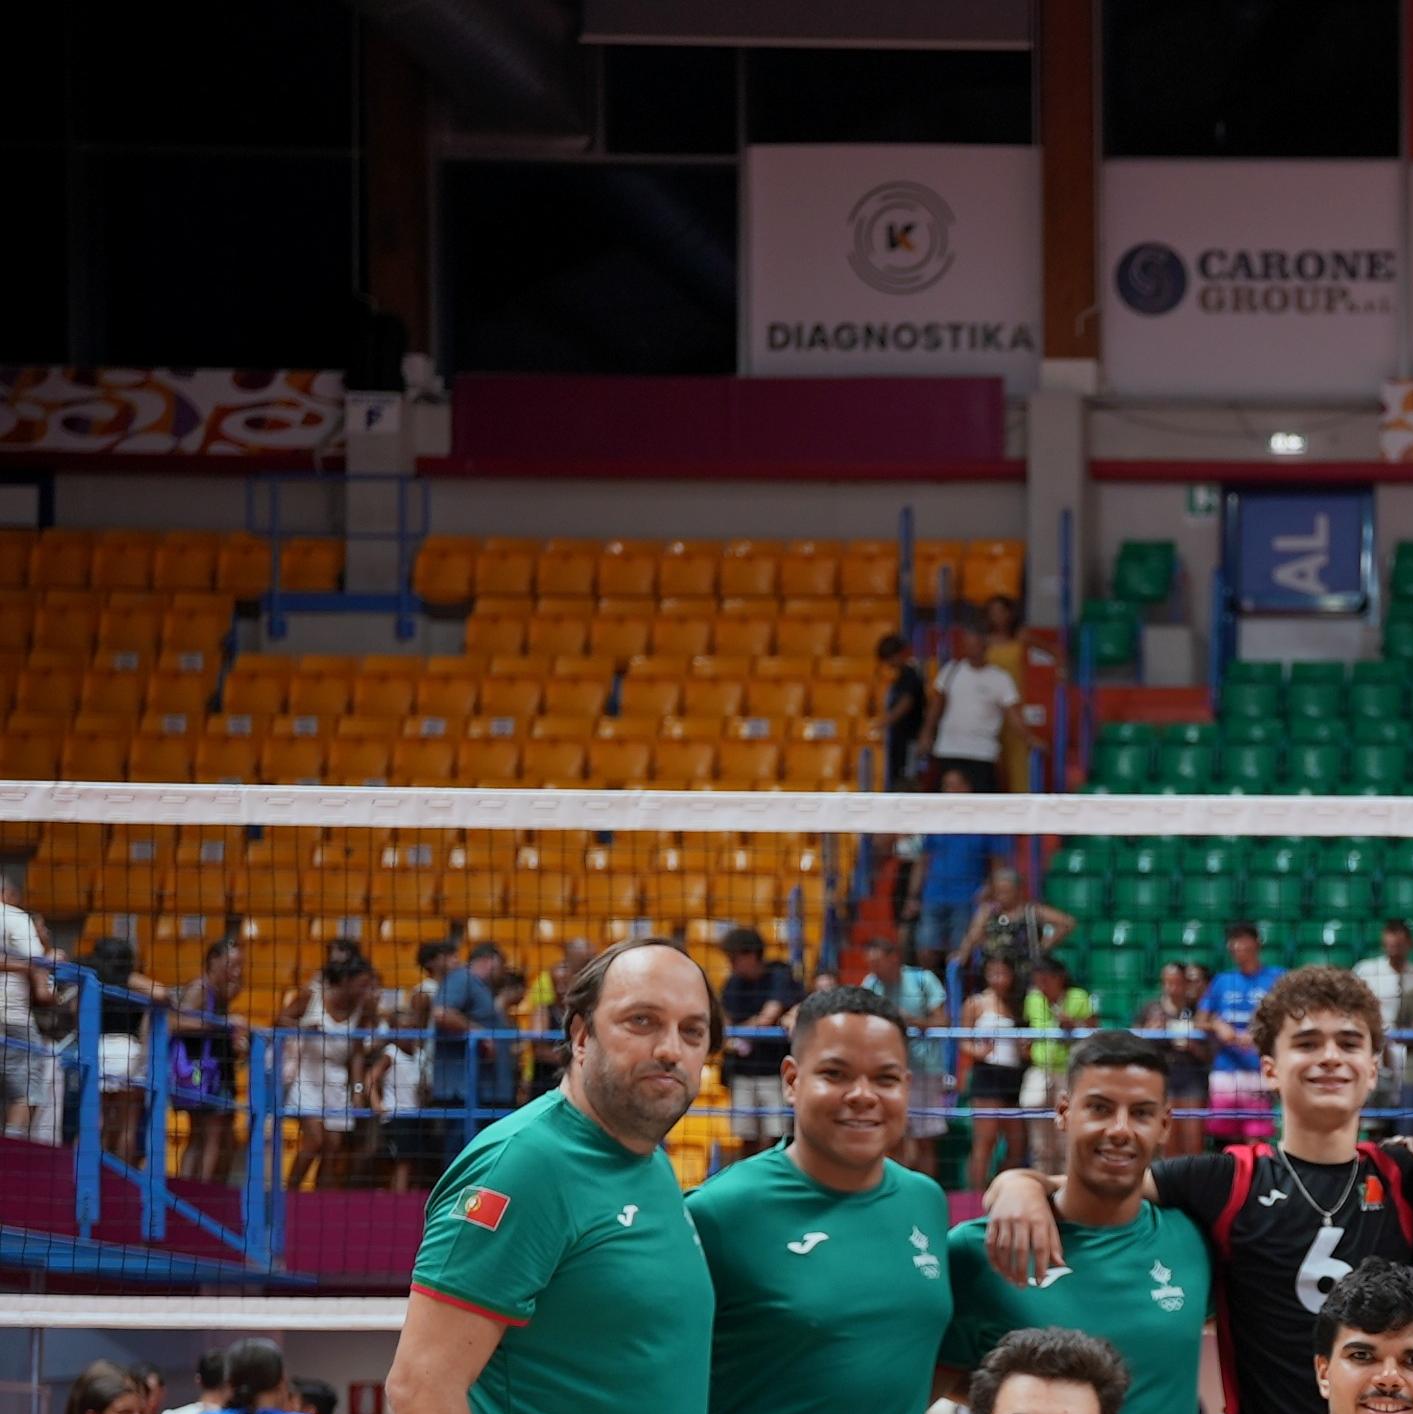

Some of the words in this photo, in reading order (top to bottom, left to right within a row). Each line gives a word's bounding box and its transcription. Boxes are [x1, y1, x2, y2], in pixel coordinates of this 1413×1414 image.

[1199, 249, 1397, 281] CARONE
[1200, 285, 1350, 314] GROUP
[767, 322, 1035, 353] DIAGNOSTIKA
[1294, 1226, 1354, 1315] 6
